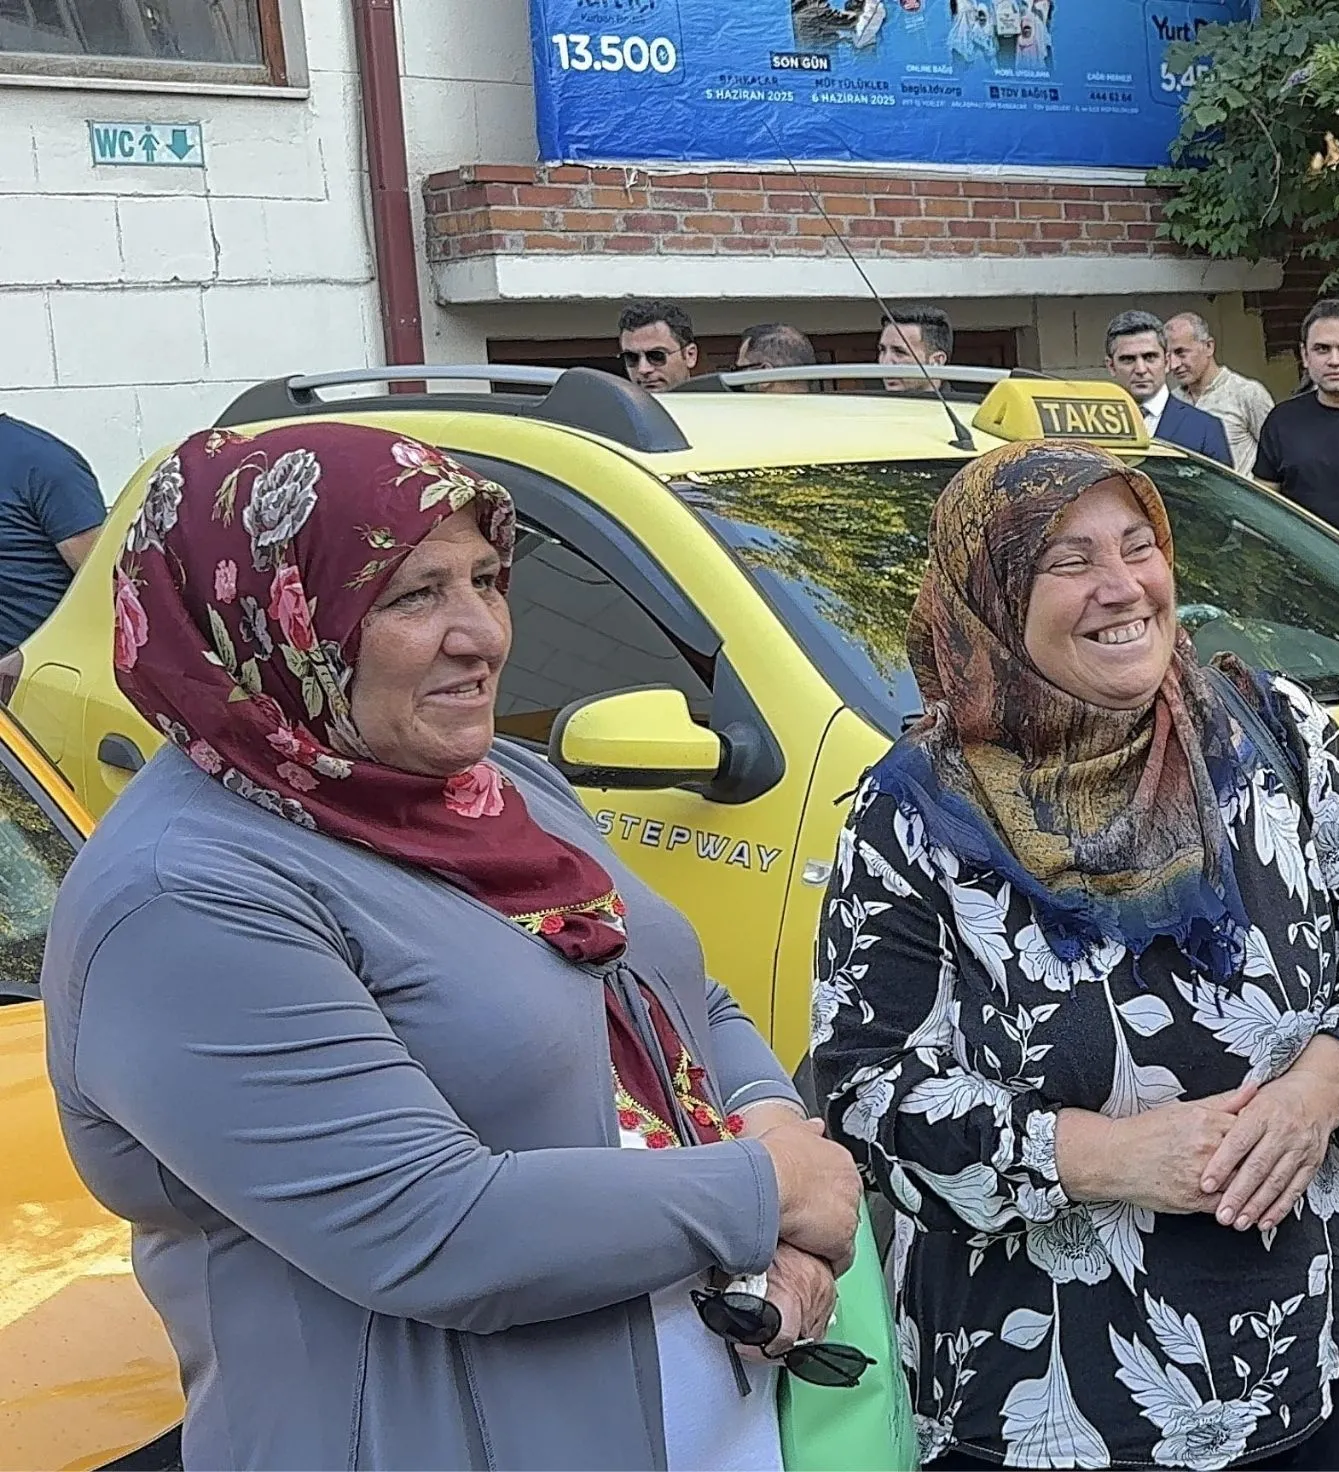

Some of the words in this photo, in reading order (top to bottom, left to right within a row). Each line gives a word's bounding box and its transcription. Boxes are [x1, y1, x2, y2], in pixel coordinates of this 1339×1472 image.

[1151, 14, 1191, 42] Yurt
[552, 33, 676, 74] 13.500
[772, 56, 799, 69] SON
[802, 57, 829, 70] GÜN
[705, 89, 714, 99] 5
[716, 89, 765, 101] HAZİRAN
[768, 91, 794, 102] 2025
[811, 93, 819, 103] 6
[821, 92, 869, 104] HAZİRAN
[871, 94, 896, 106] 2025
[94, 128, 135, 158] WC
[595, 809, 783, 873] STEPWAY
